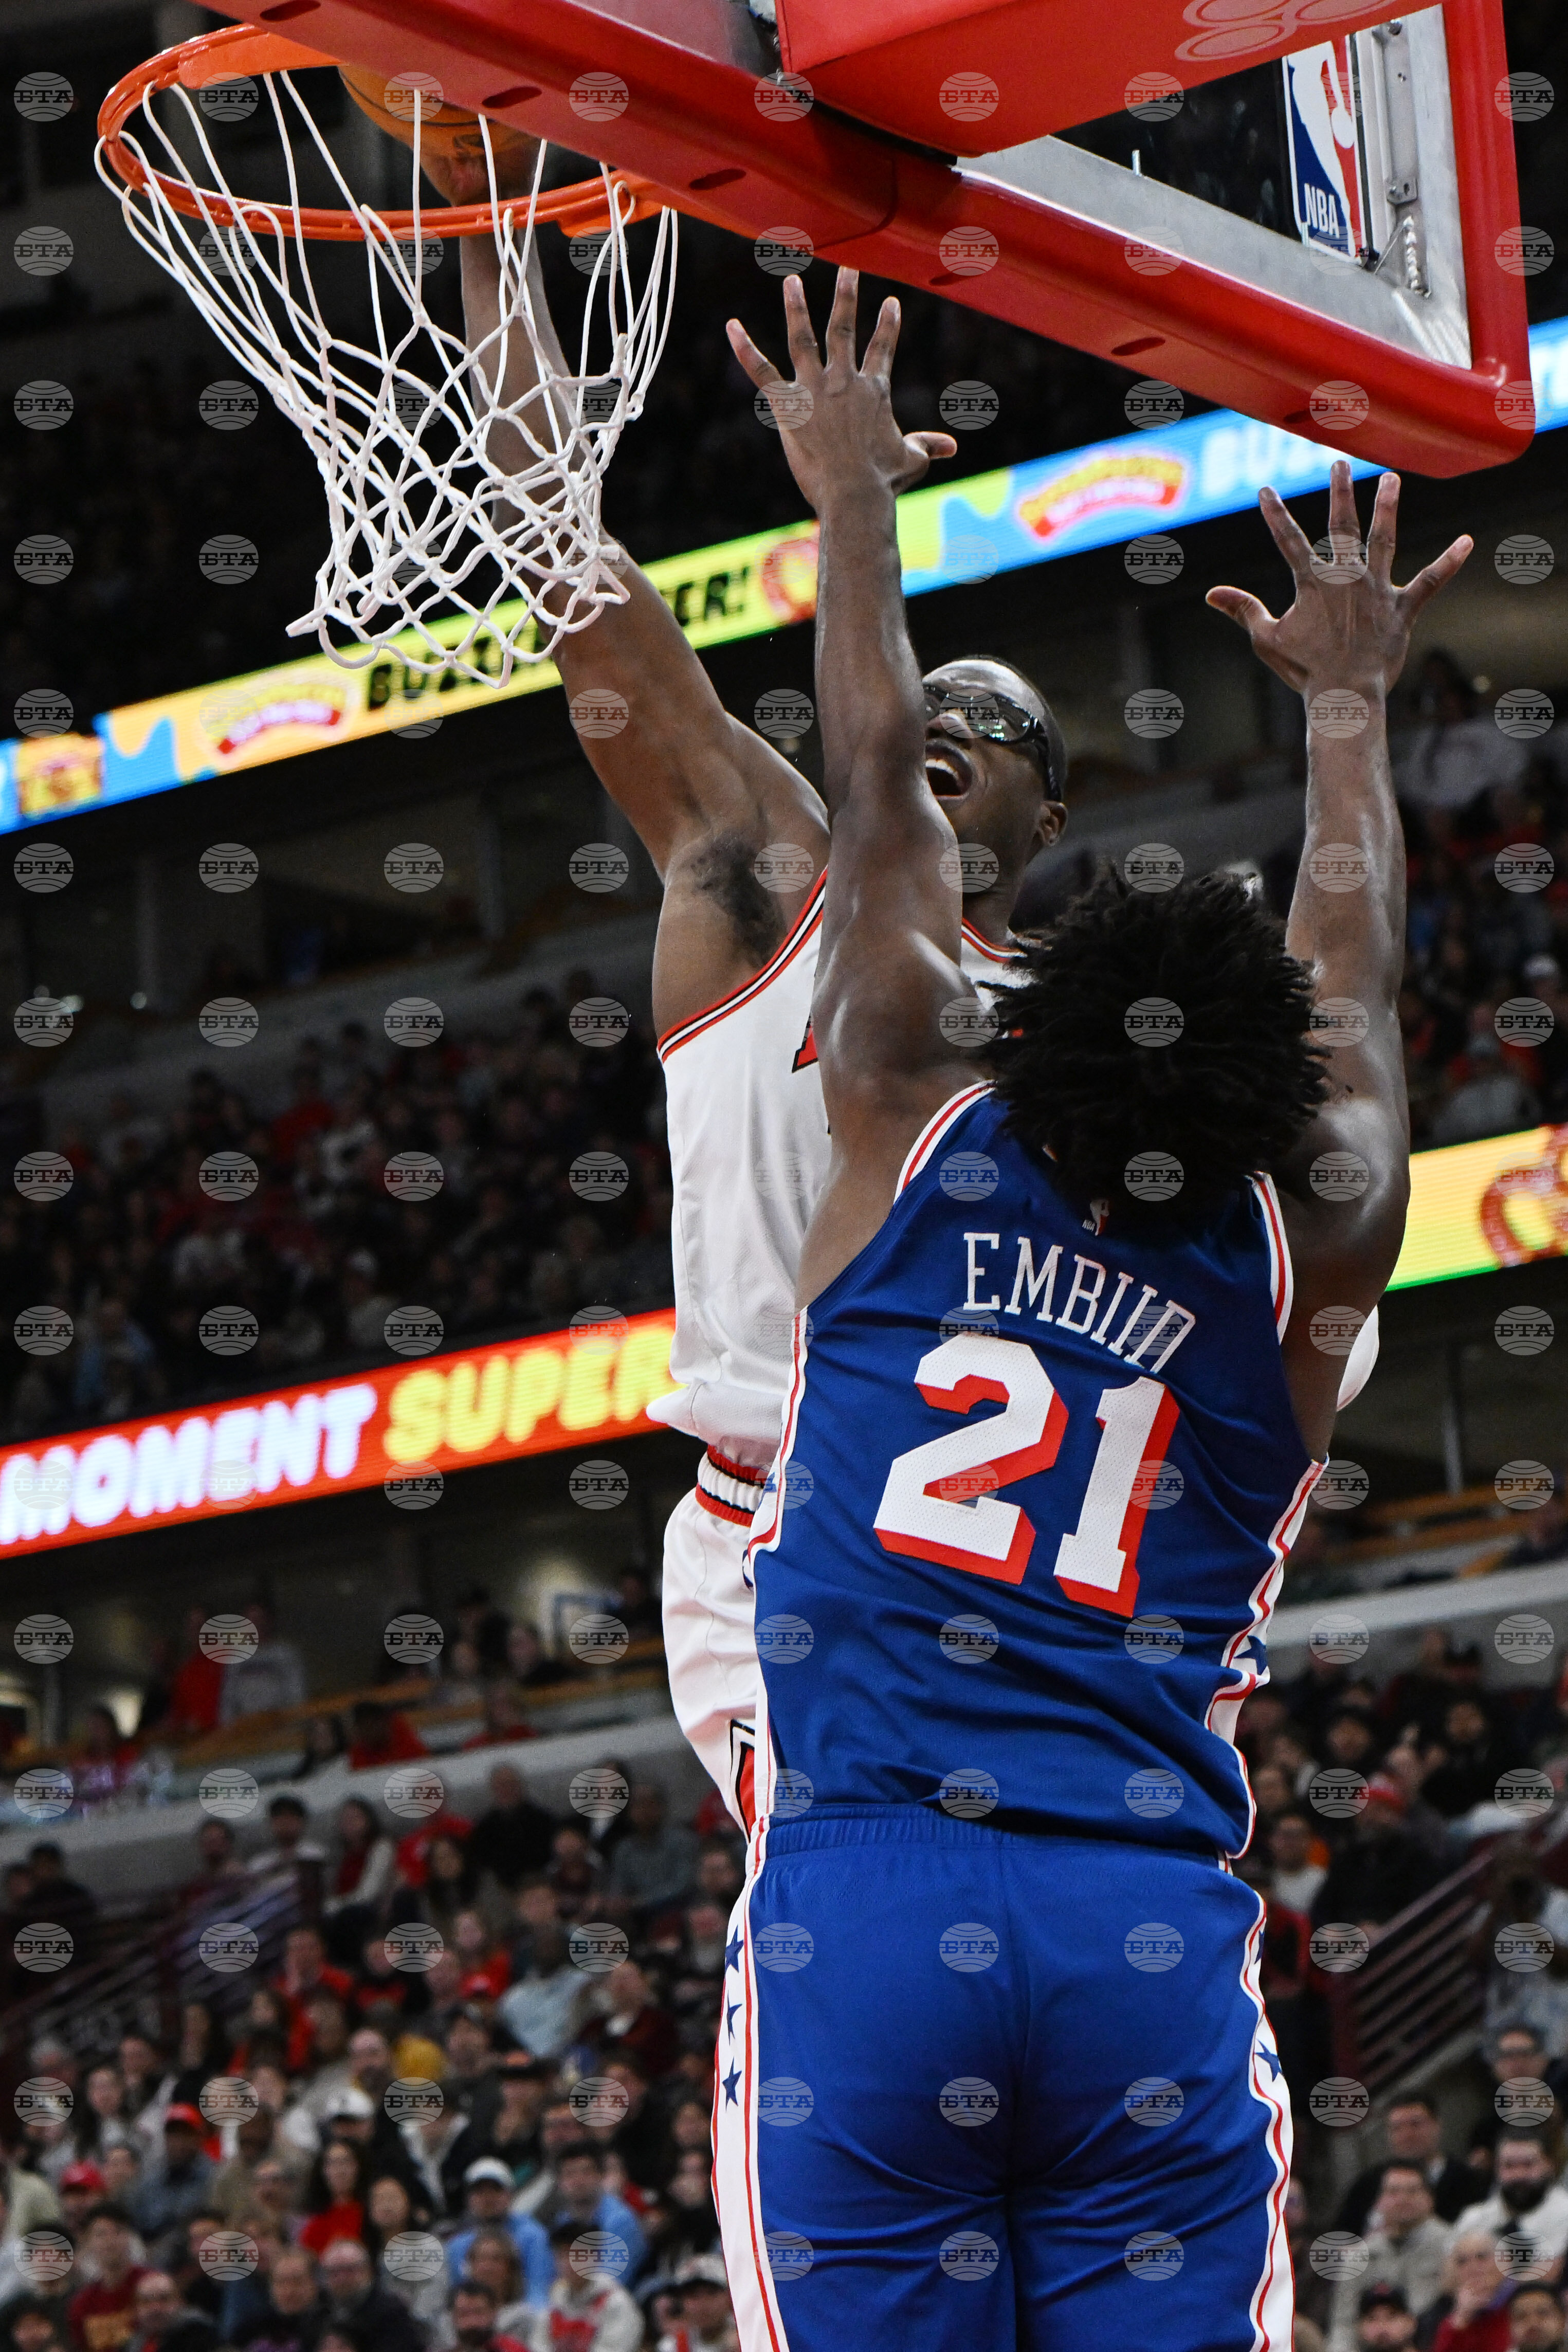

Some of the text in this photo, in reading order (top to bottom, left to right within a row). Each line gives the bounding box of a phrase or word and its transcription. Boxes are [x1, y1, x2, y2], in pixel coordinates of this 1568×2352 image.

[1304, 183, 1340, 239] NBA
[1082, 1219, 1096, 1232] NBA
[963, 1232, 1196, 1375] EMBIID
[0, 1382, 377, 1544] MOMENT
[873, 1331, 1180, 1618] 21
